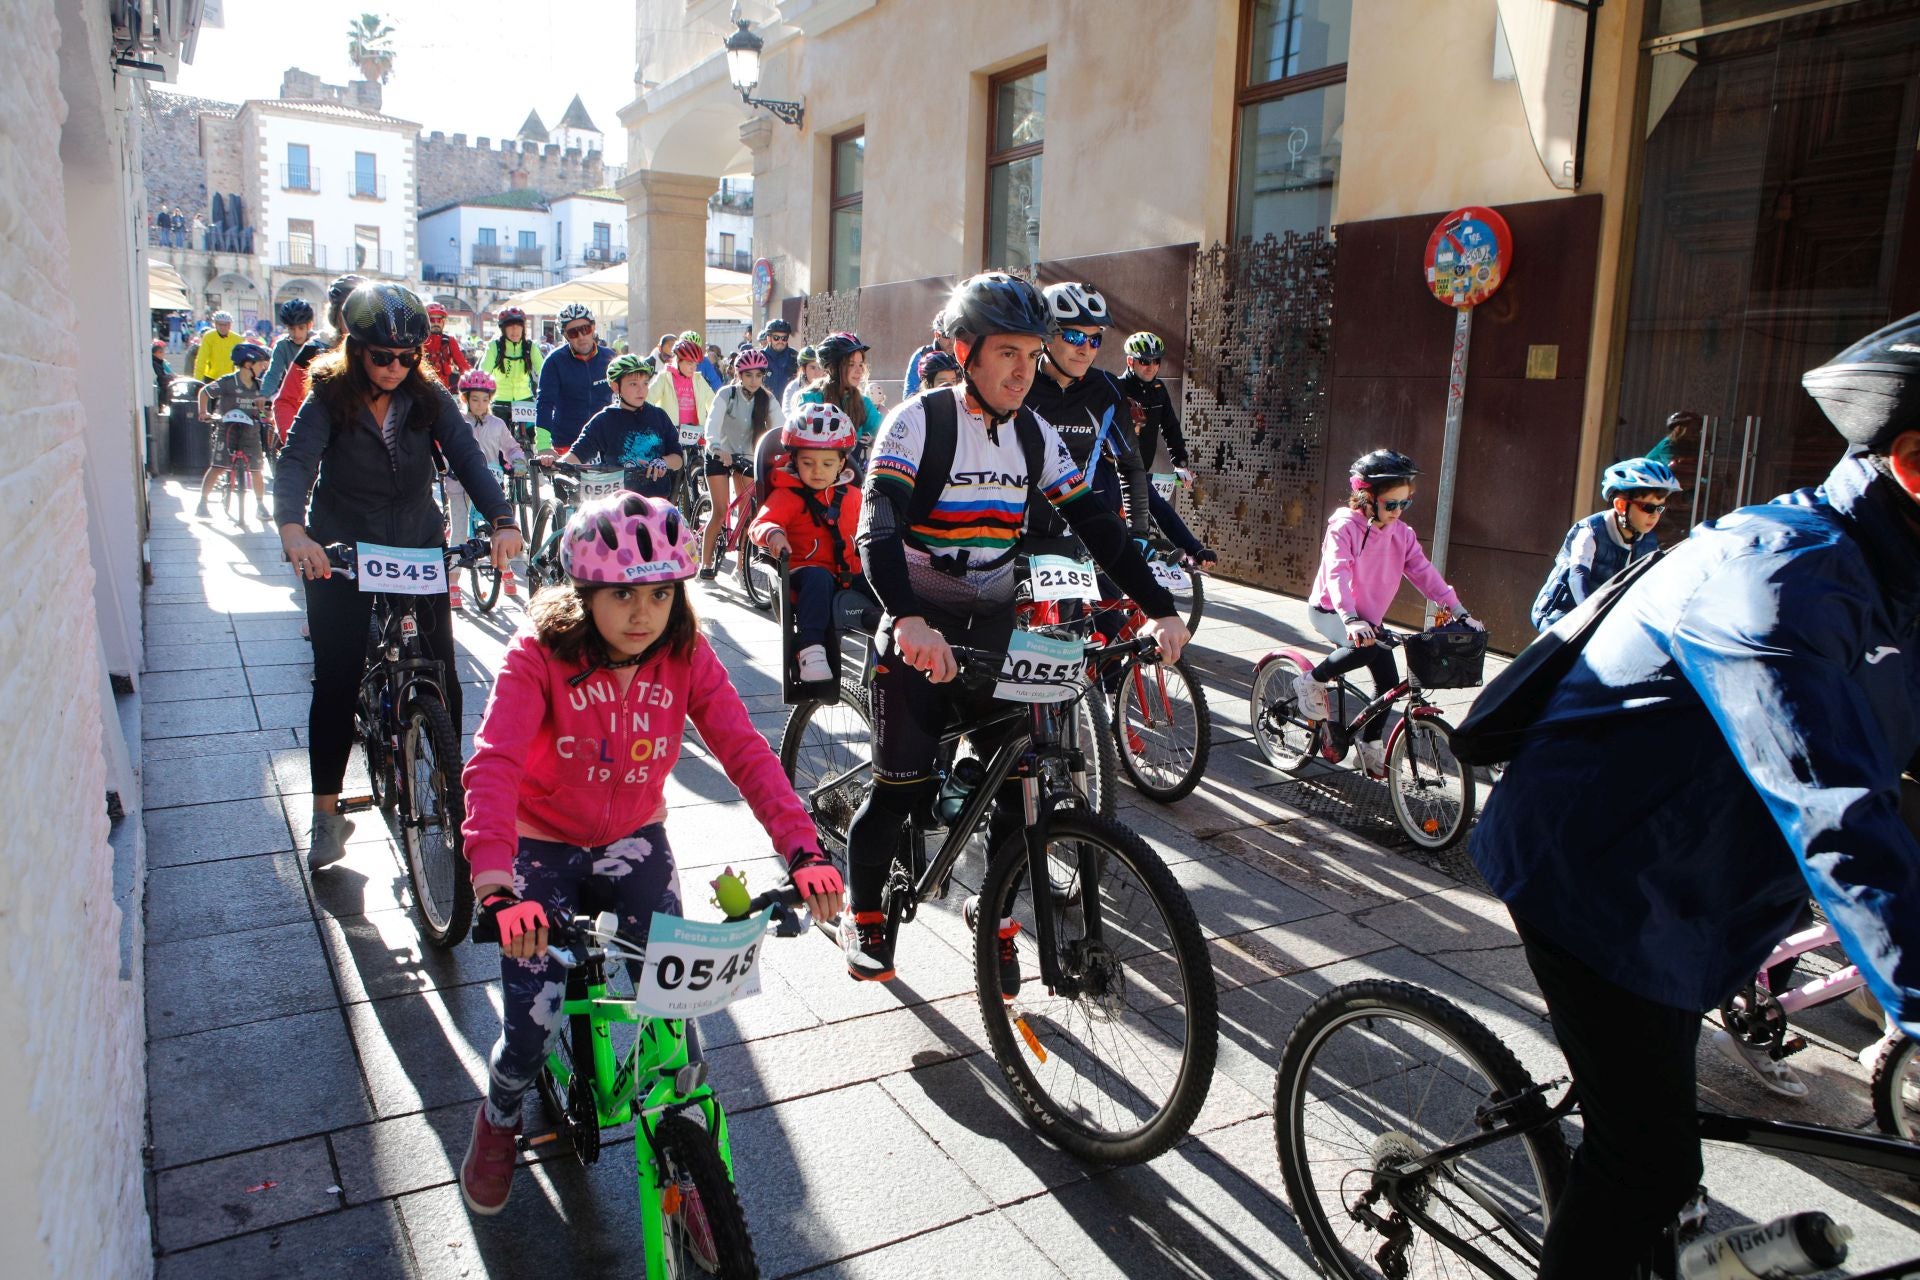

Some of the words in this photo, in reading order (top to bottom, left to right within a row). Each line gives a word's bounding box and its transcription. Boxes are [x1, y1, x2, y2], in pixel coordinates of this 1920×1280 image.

[366, 559, 438, 581] 0545
[626, 562, 673, 577] PAULA
[1039, 570, 1092, 588] 2185
[1011, 659, 1083, 682] 0553
[895, 770, 918, 778] TECH
[673, 928, 708, 943] Fiesta
[1006, 1065, 1055, 1125] MAXXIS
